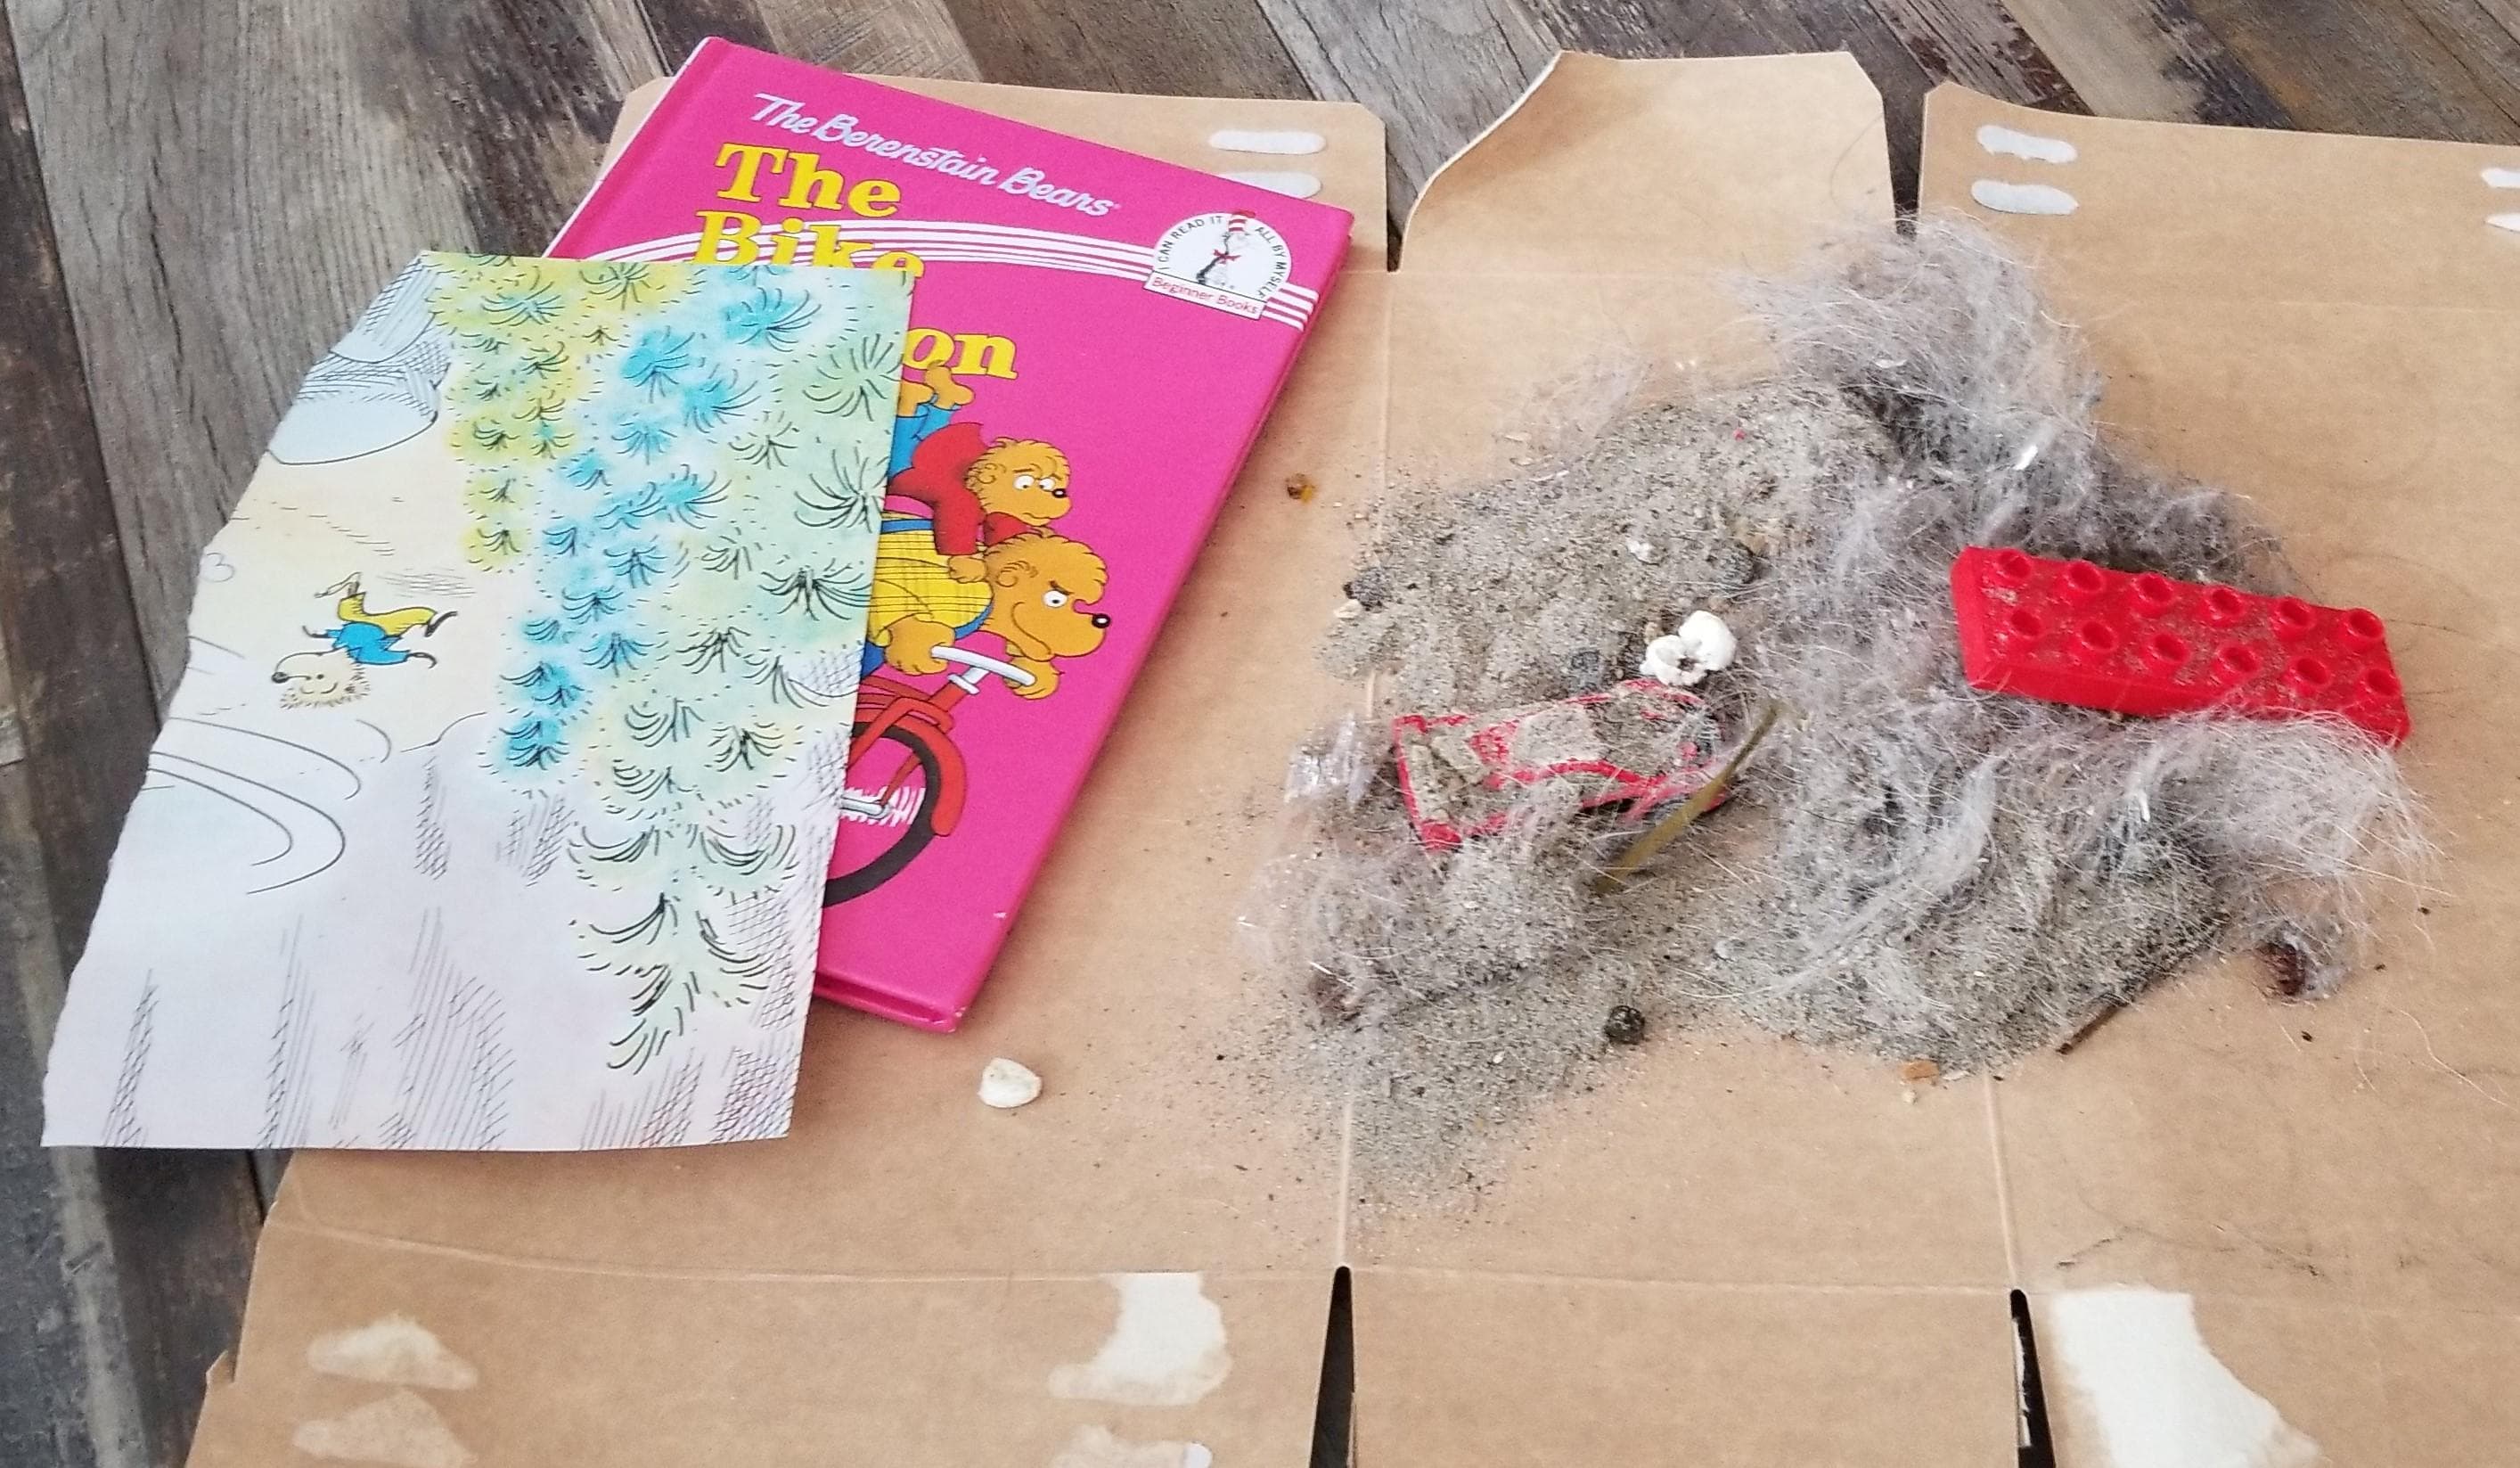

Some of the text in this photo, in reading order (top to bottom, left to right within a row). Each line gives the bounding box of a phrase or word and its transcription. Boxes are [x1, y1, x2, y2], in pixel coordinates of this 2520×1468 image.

[715, 143, 902, 217] The
[750, 92, 1114, 217] The Berenstain Bears
[691, 209, 924, 276] Bike
[1158, 241, 1174, 263] CAN
[1170, 218, 1205, 241] READ
[1210, 215, 1223, 225] IT
[1254, 226, 1275, 244] ALL
[1272, 244, 1288, 258] BY
[1151, 276, 1259, 315] Beginner Books
